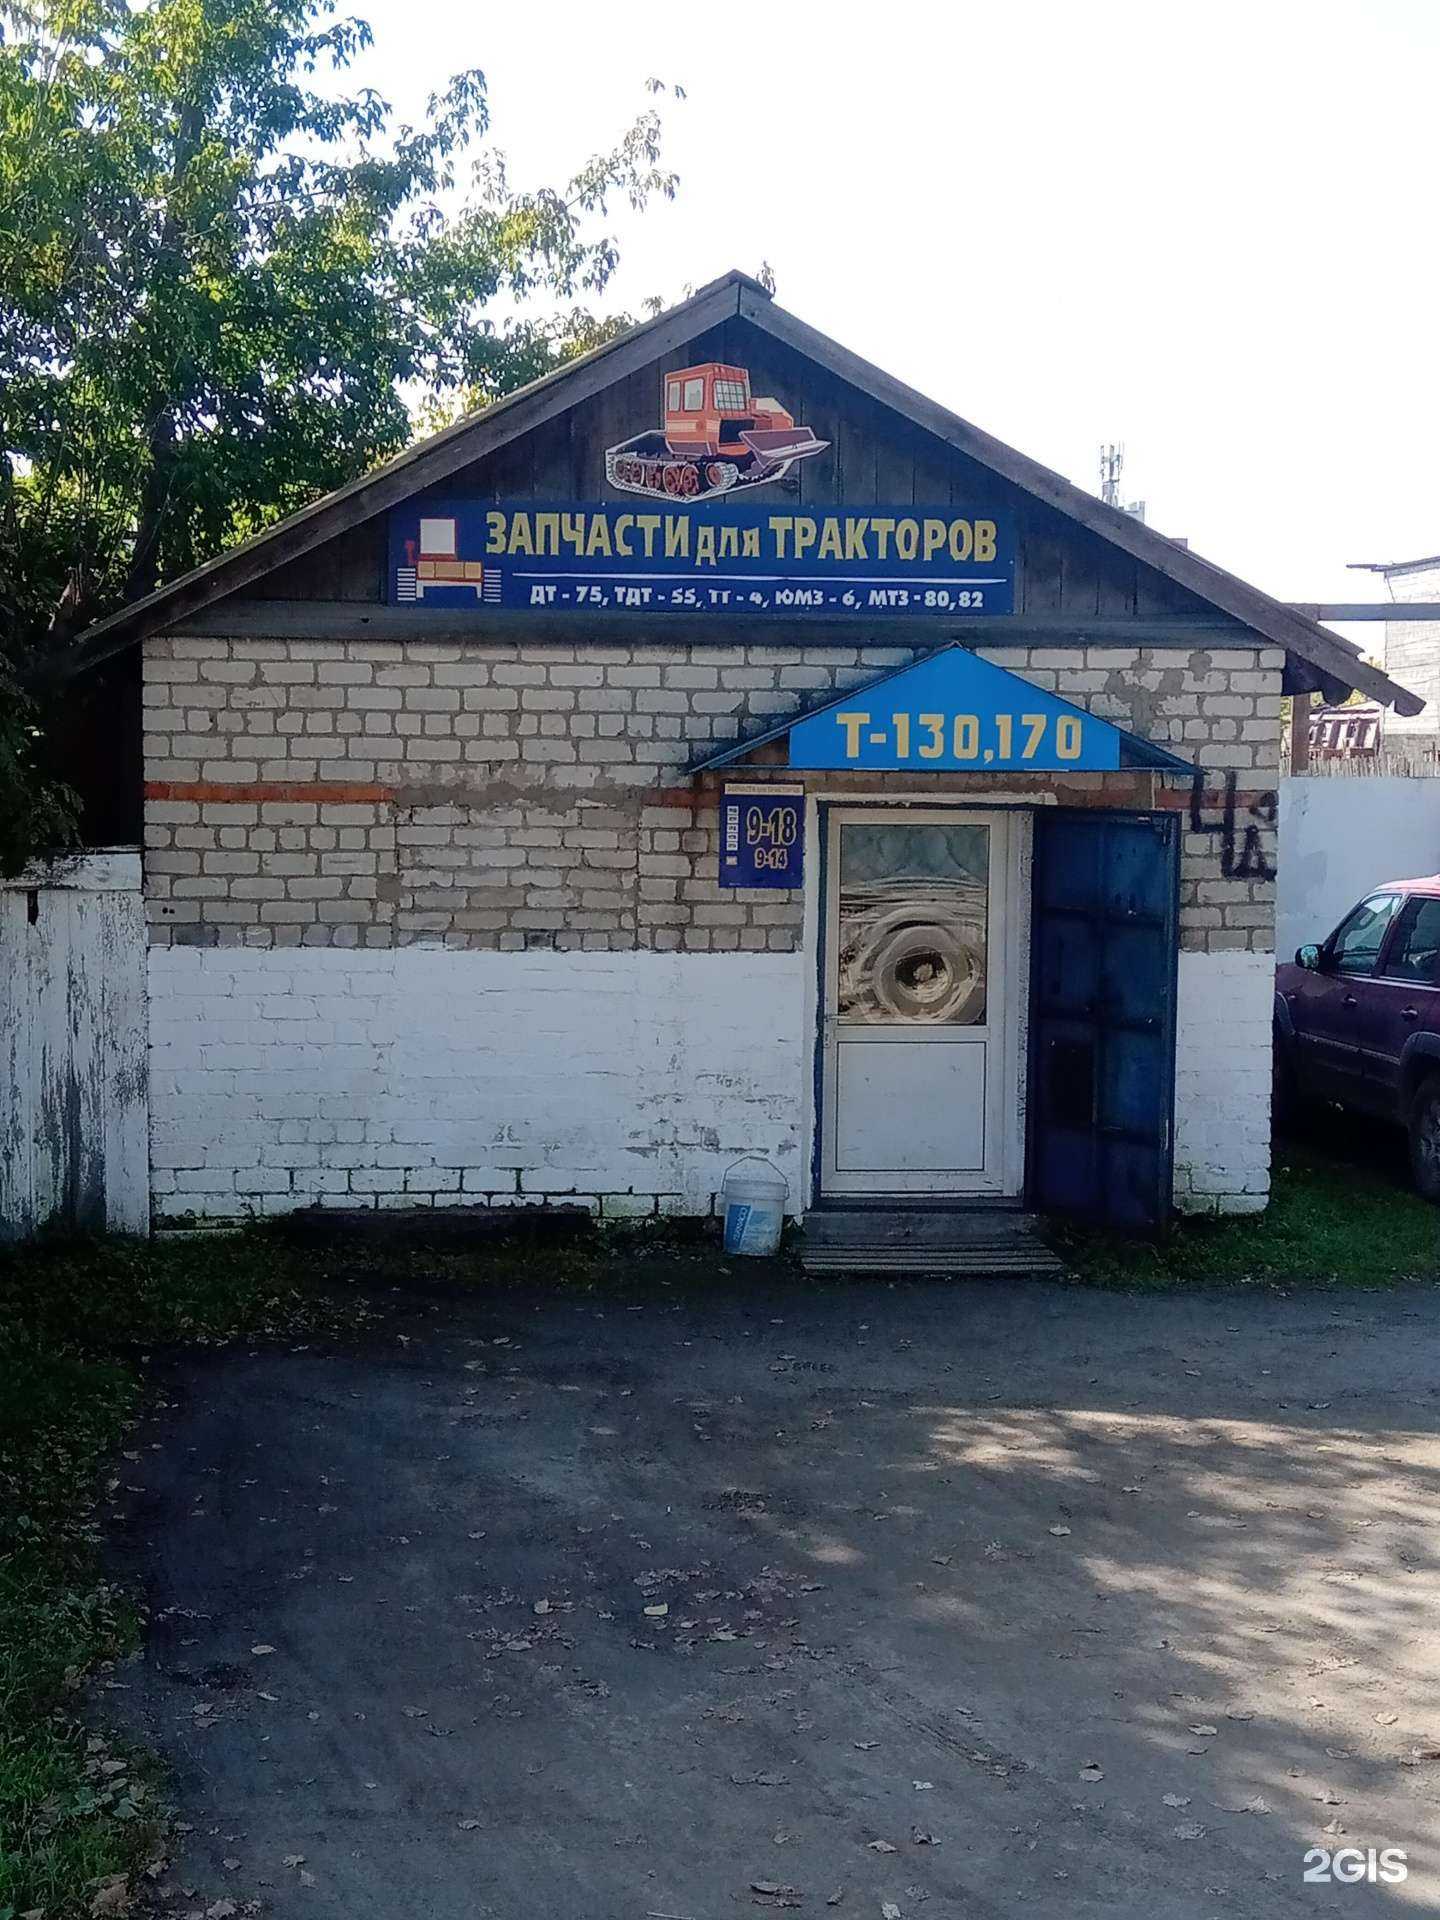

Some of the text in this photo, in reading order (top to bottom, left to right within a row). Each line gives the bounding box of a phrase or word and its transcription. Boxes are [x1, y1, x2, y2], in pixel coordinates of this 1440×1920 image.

[486, 511, 997, 566] ЗАПЧАСТИ для ТРАКТОРОВ
[746, 806, 797, 846] 9-18
